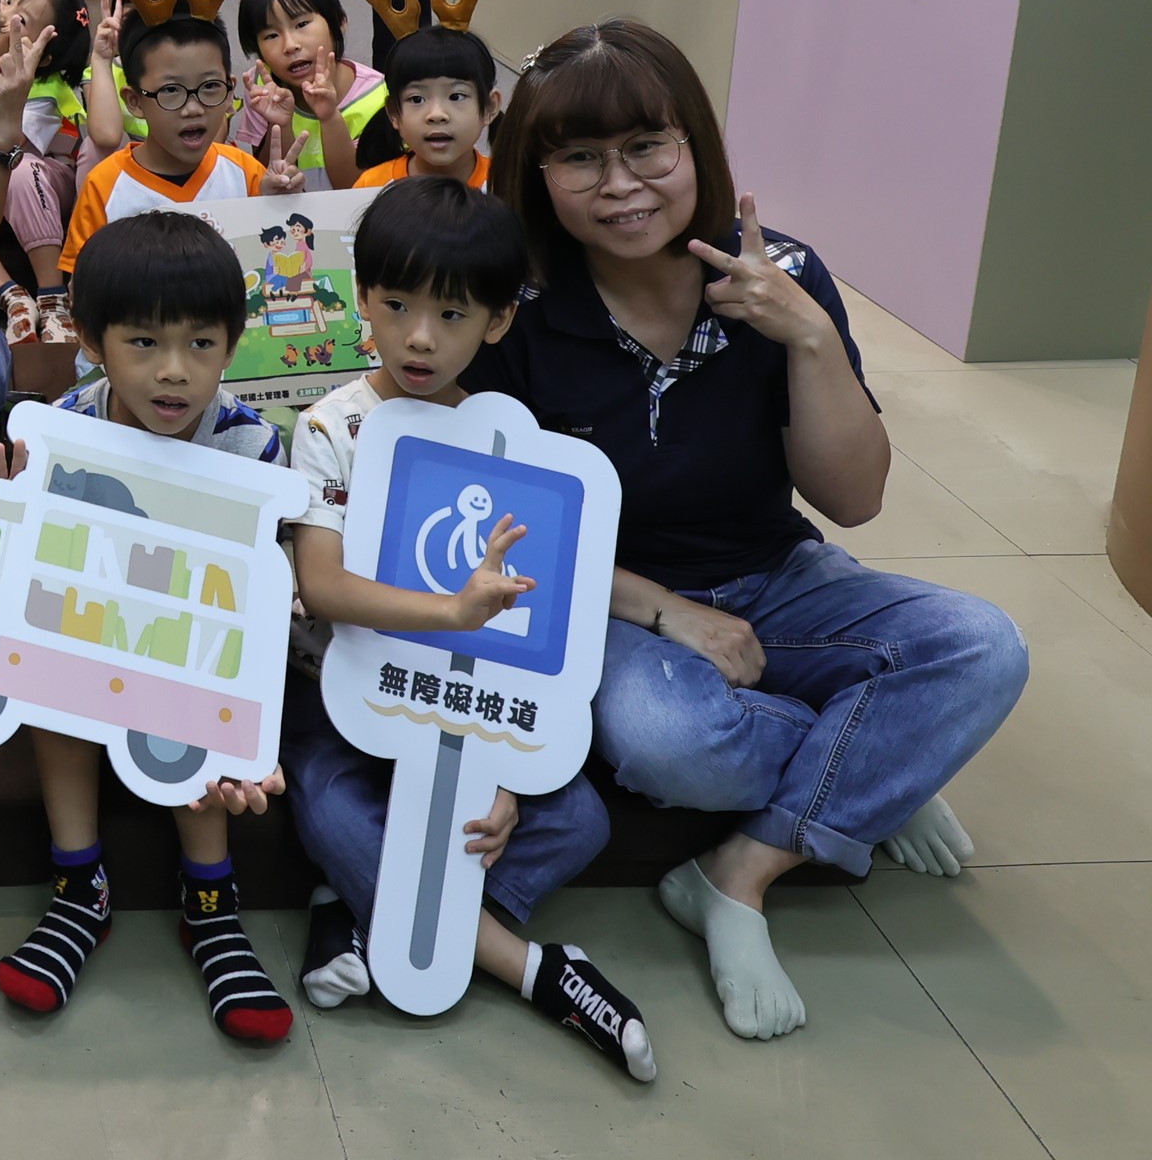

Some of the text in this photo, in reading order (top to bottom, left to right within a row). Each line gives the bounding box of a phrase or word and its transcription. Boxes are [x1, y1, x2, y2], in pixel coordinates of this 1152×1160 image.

[378, 662, 539, 732] 無障礙坡道
[559, 963, 623, 1045] TOMICA
